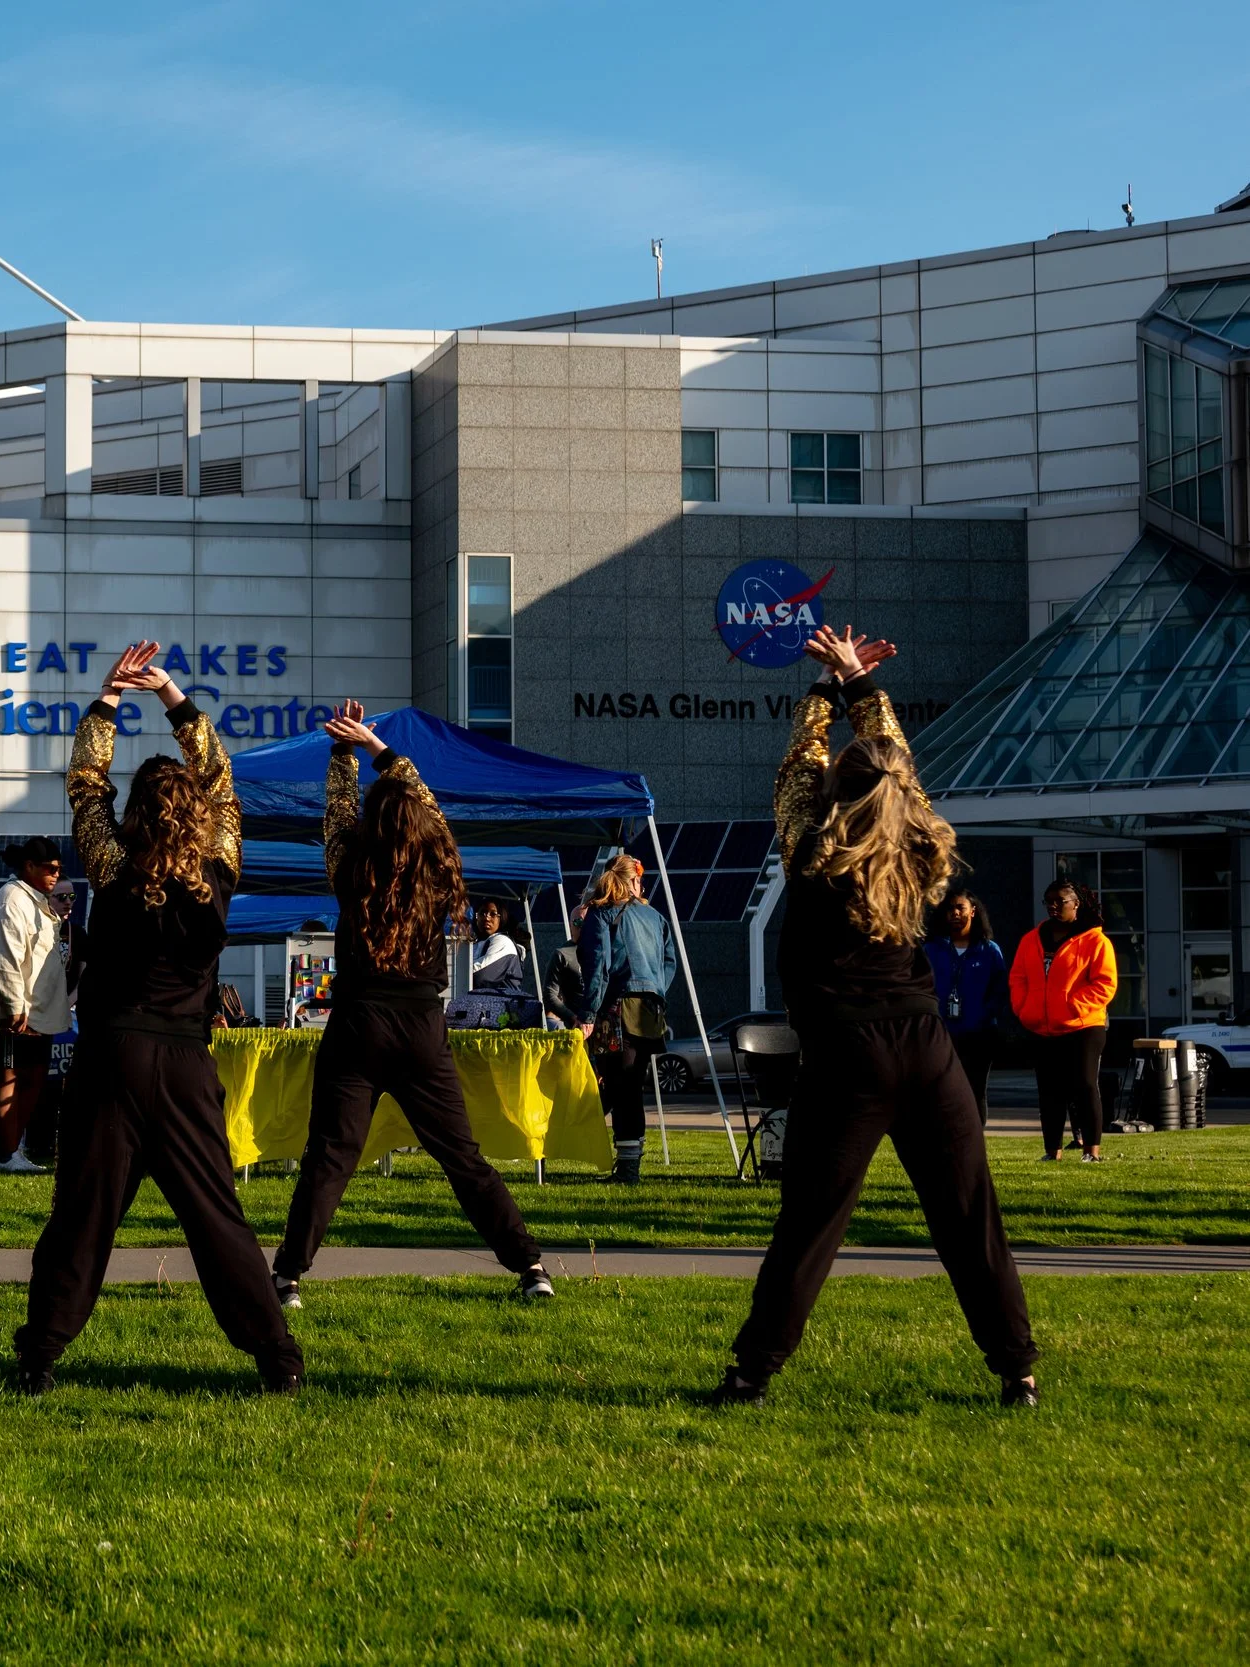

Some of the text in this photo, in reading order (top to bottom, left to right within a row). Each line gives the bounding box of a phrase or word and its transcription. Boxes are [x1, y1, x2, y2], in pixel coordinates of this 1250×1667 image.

[726, 602, 817, 626] NASA
[133, 643, 288, 677] AKES
[574, 692, 660, 719] NASA
[669, 693, 756, 720] Glenn
[51, 1042, 75, 1059] RID
